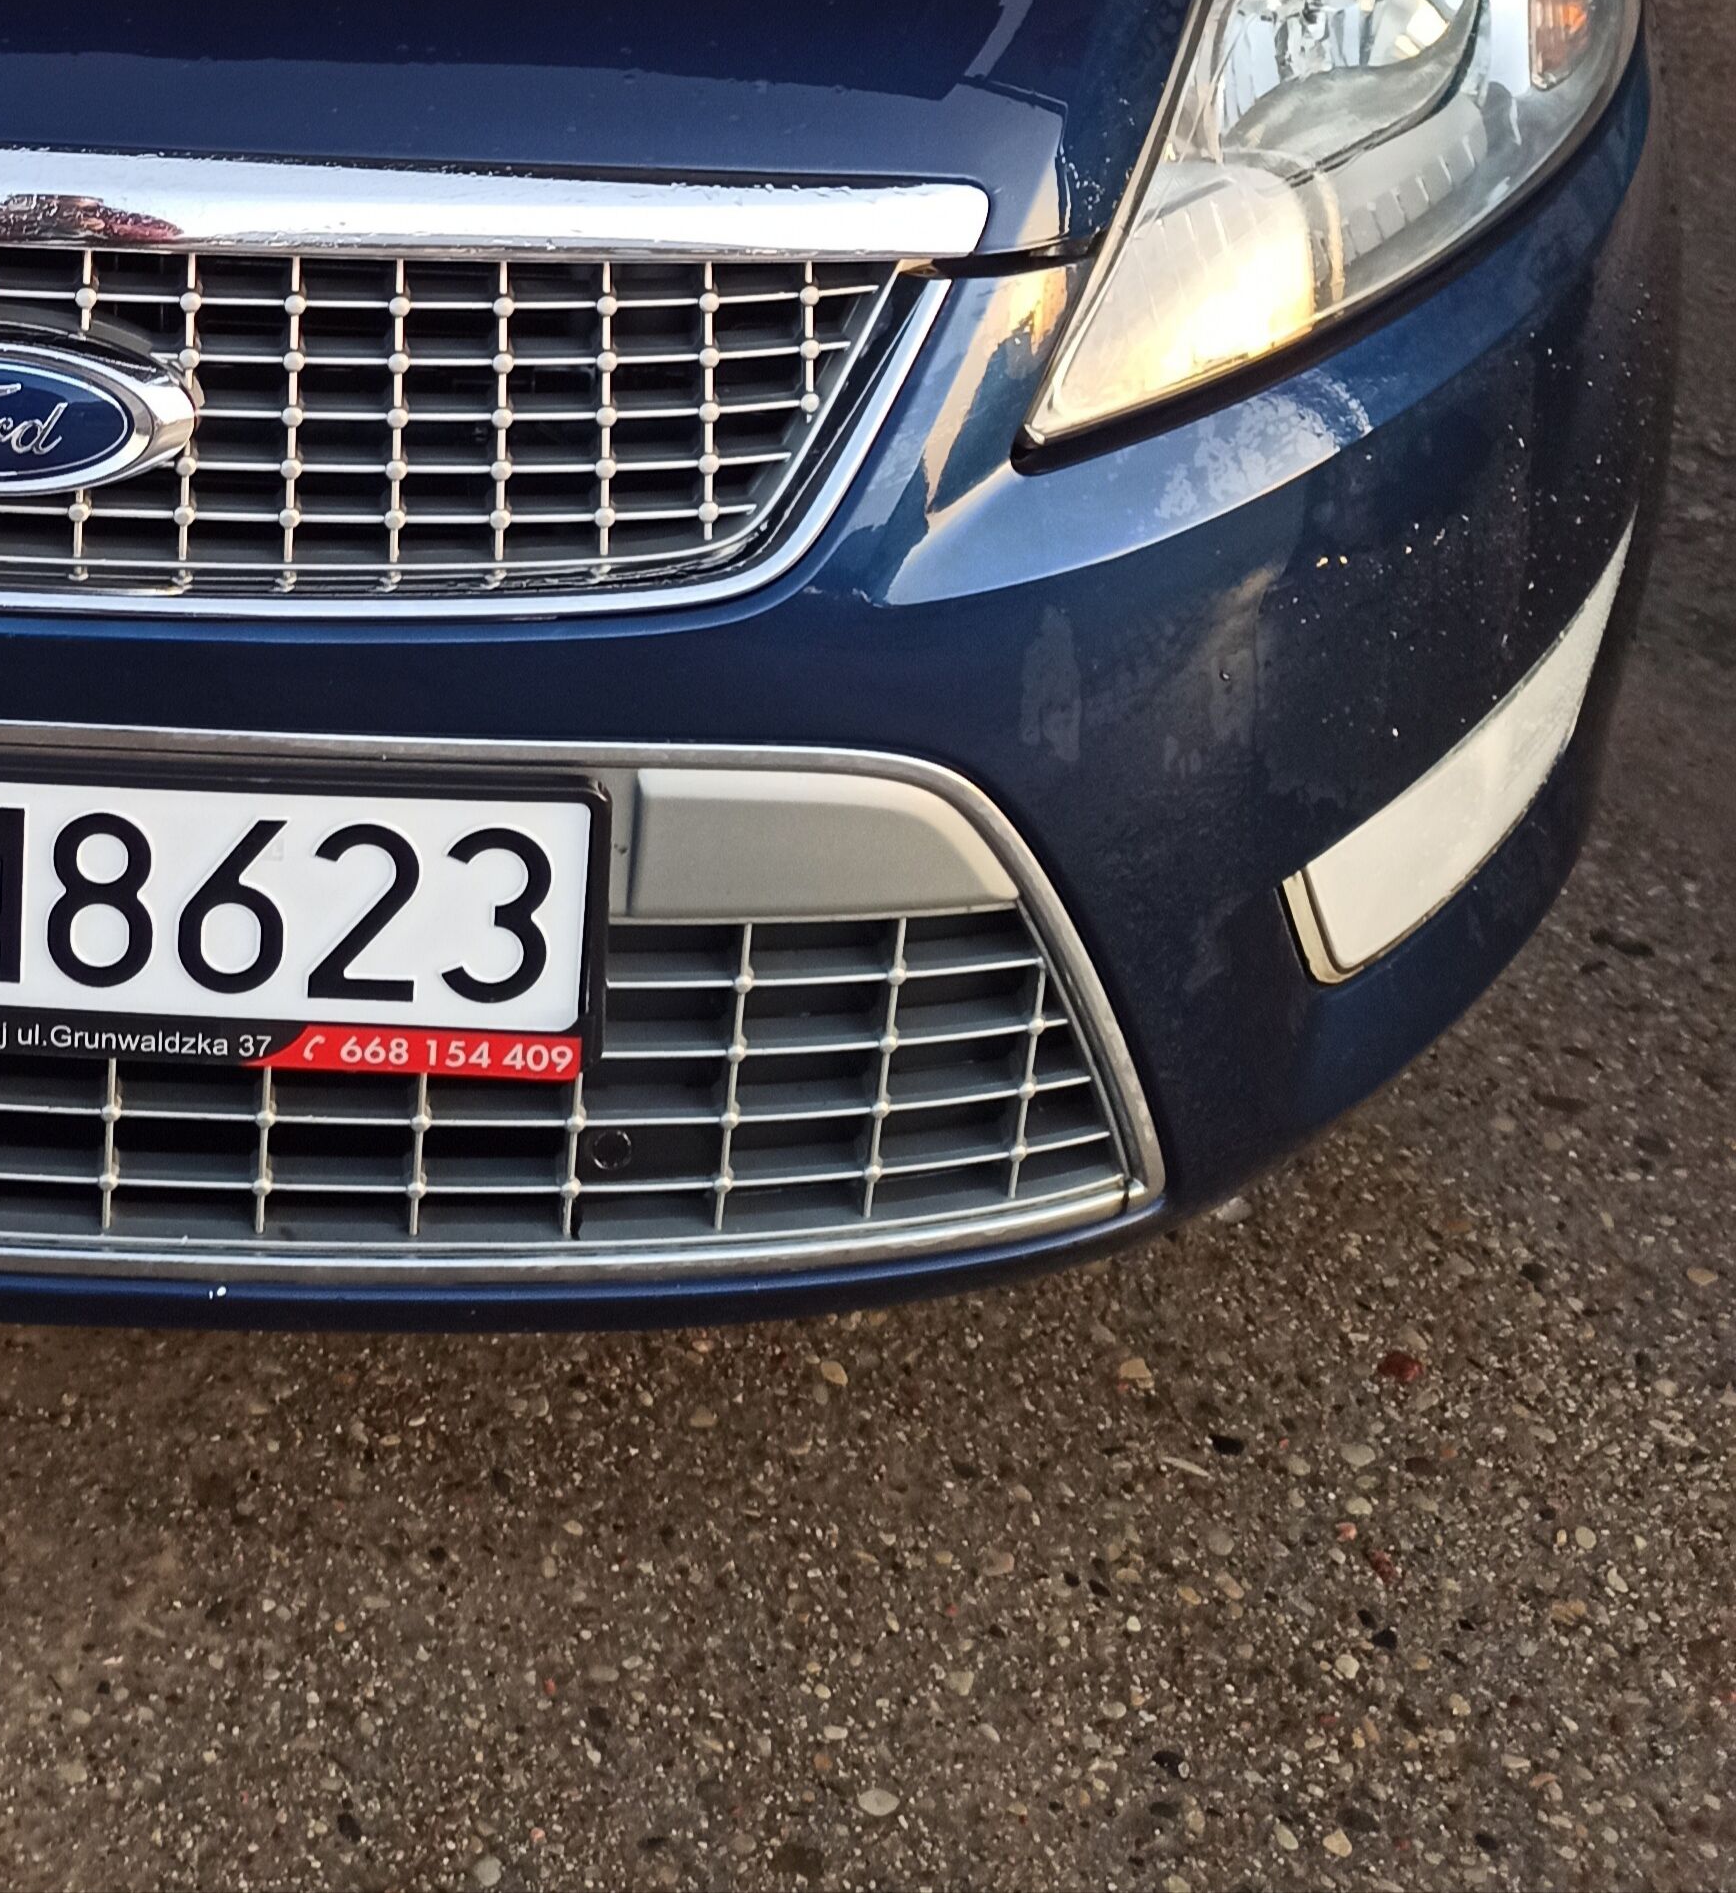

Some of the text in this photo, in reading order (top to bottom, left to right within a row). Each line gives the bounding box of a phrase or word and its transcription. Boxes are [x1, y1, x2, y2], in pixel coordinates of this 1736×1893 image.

[238, 1034, 273, 1059] 37
[340, 1035, 574, 1074] 668 154 409
